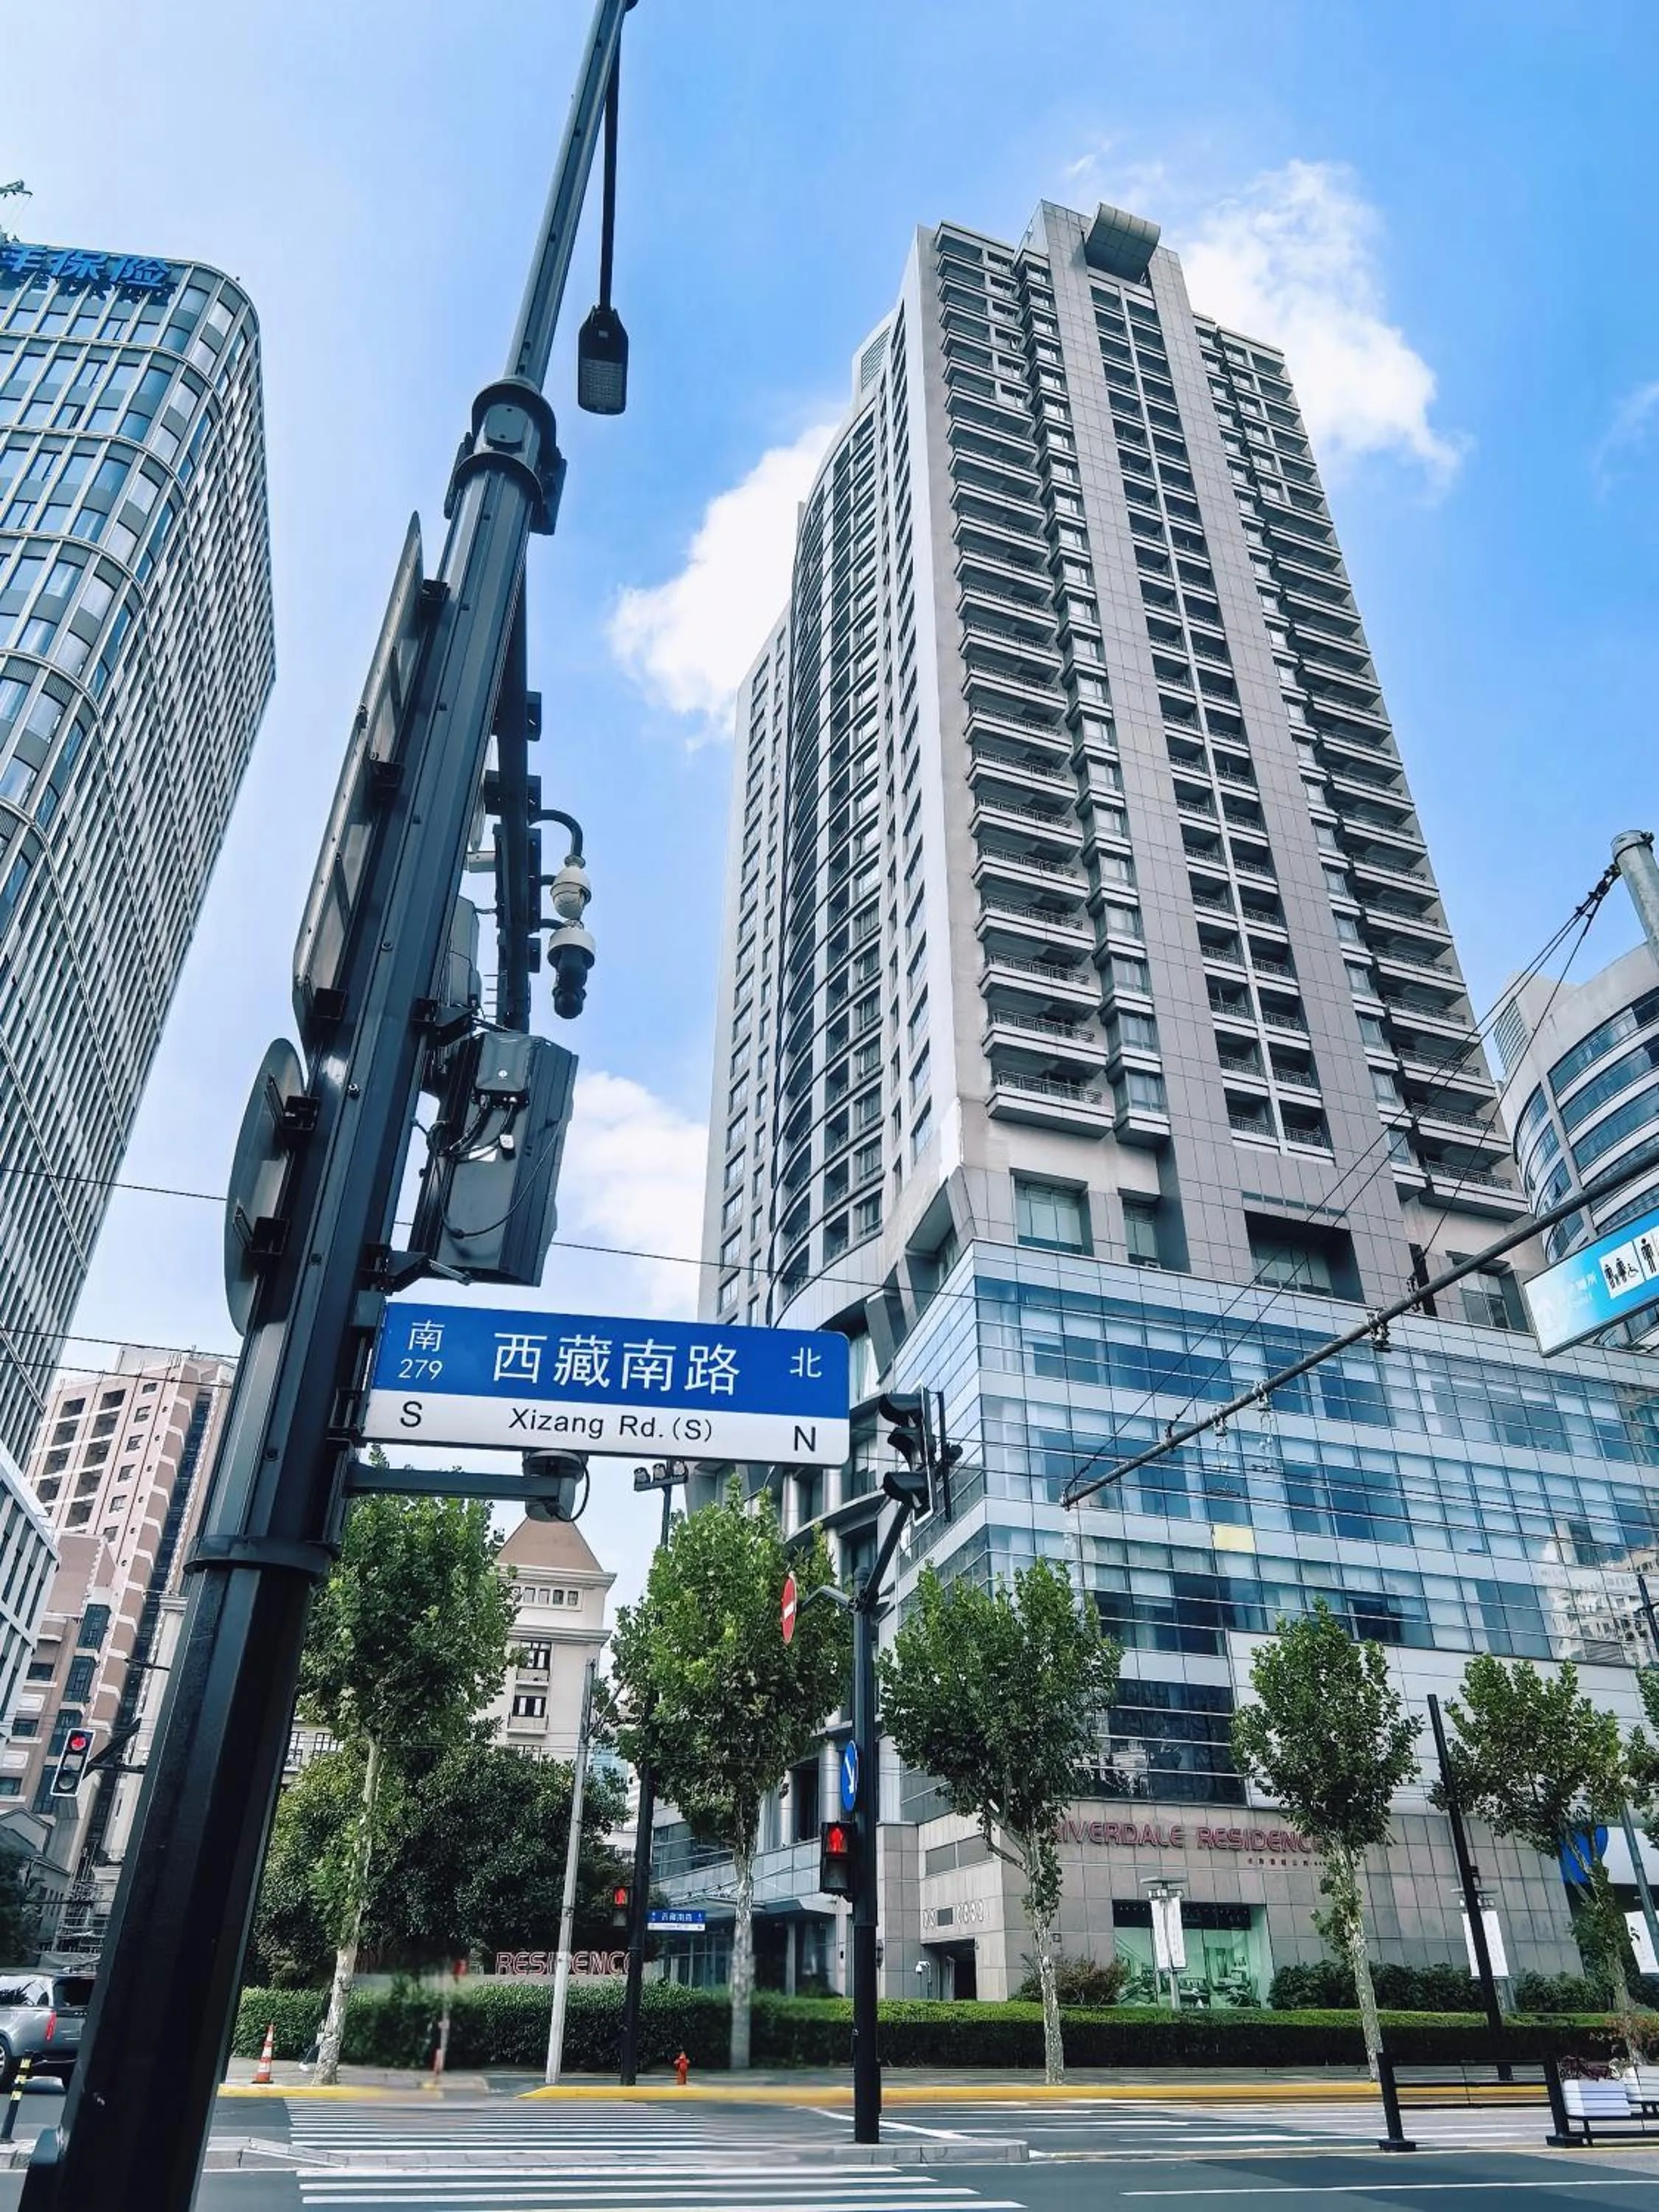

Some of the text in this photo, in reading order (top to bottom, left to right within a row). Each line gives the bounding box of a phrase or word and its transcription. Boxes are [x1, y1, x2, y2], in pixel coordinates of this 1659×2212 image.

[408, 1319, 445, 1352] 南
[398, 1358, 442, 1380] 279
[493, 1332, 740, 1396] 西藏南路
[790, 1347, 822, 1377] 北
[400, 1400, 422, 1427] S
[508, 1408, 604, 1439] Xizang
[794, 1425, 816, 1452] N
[495, 1951, 630, 1975] RESIENC
